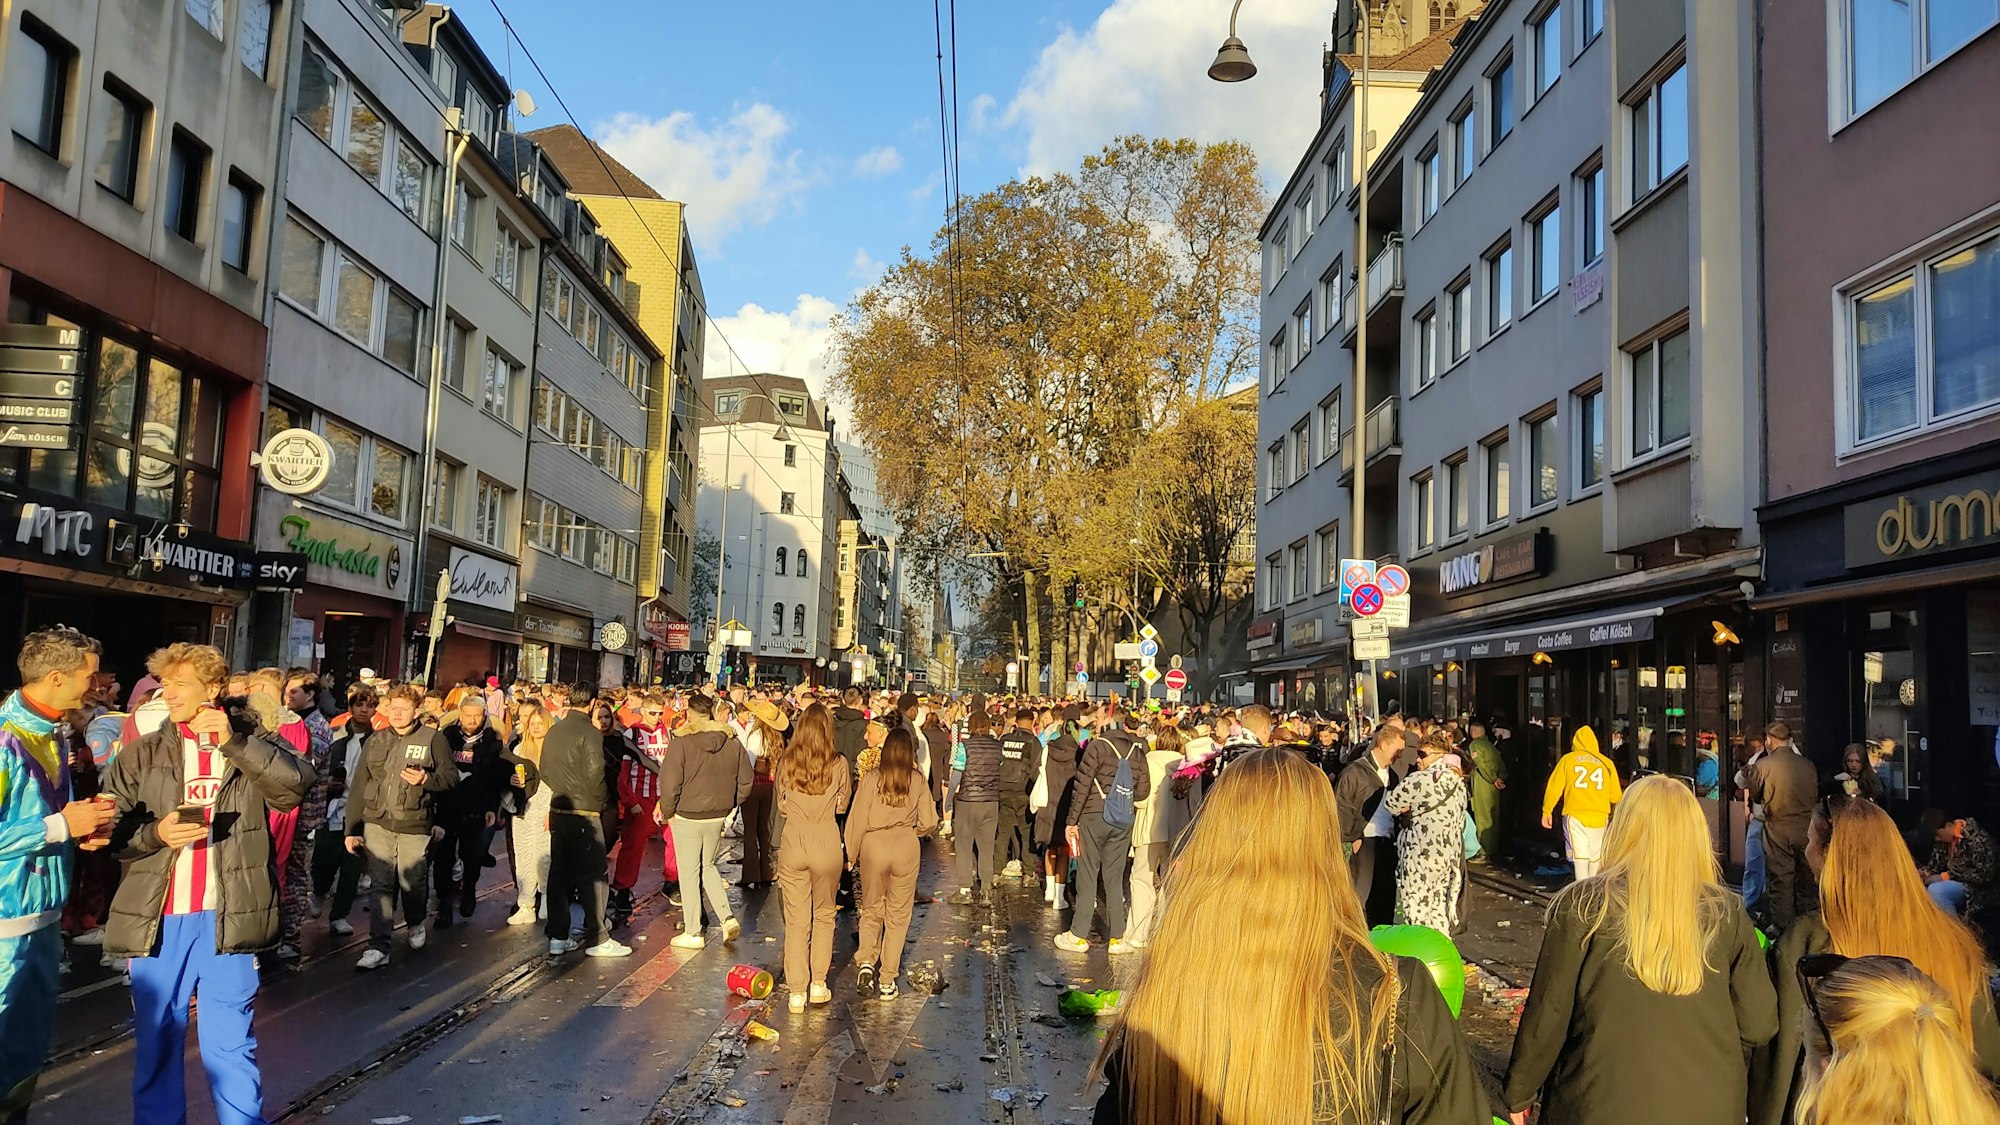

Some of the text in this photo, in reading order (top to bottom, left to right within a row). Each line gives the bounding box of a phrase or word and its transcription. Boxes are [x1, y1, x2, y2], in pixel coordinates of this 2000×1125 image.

[0, 405, 68, 418] MUSIC CLUB
[28, 432, 63, 442] KÖLSCH
[267, 455, 324, 466] KWARTIER
[15, 502, 93, 556] MTC
[143, 537, 235, 578] KWARTIER
[260, 560, 298, 583] sky
[667, 622, 690, 631] KIOSK
[1589, 622, 1633, 642] Gaffel Kölsch
[1504, 639, 1521, 655] Burger
[1538, 632, 1573, 649] Costa Coffee
[405, 744, 427, 760] FBI
[1003, 740, 1025, 749] SWAT
[1574, 765, 1604, 790] 24
